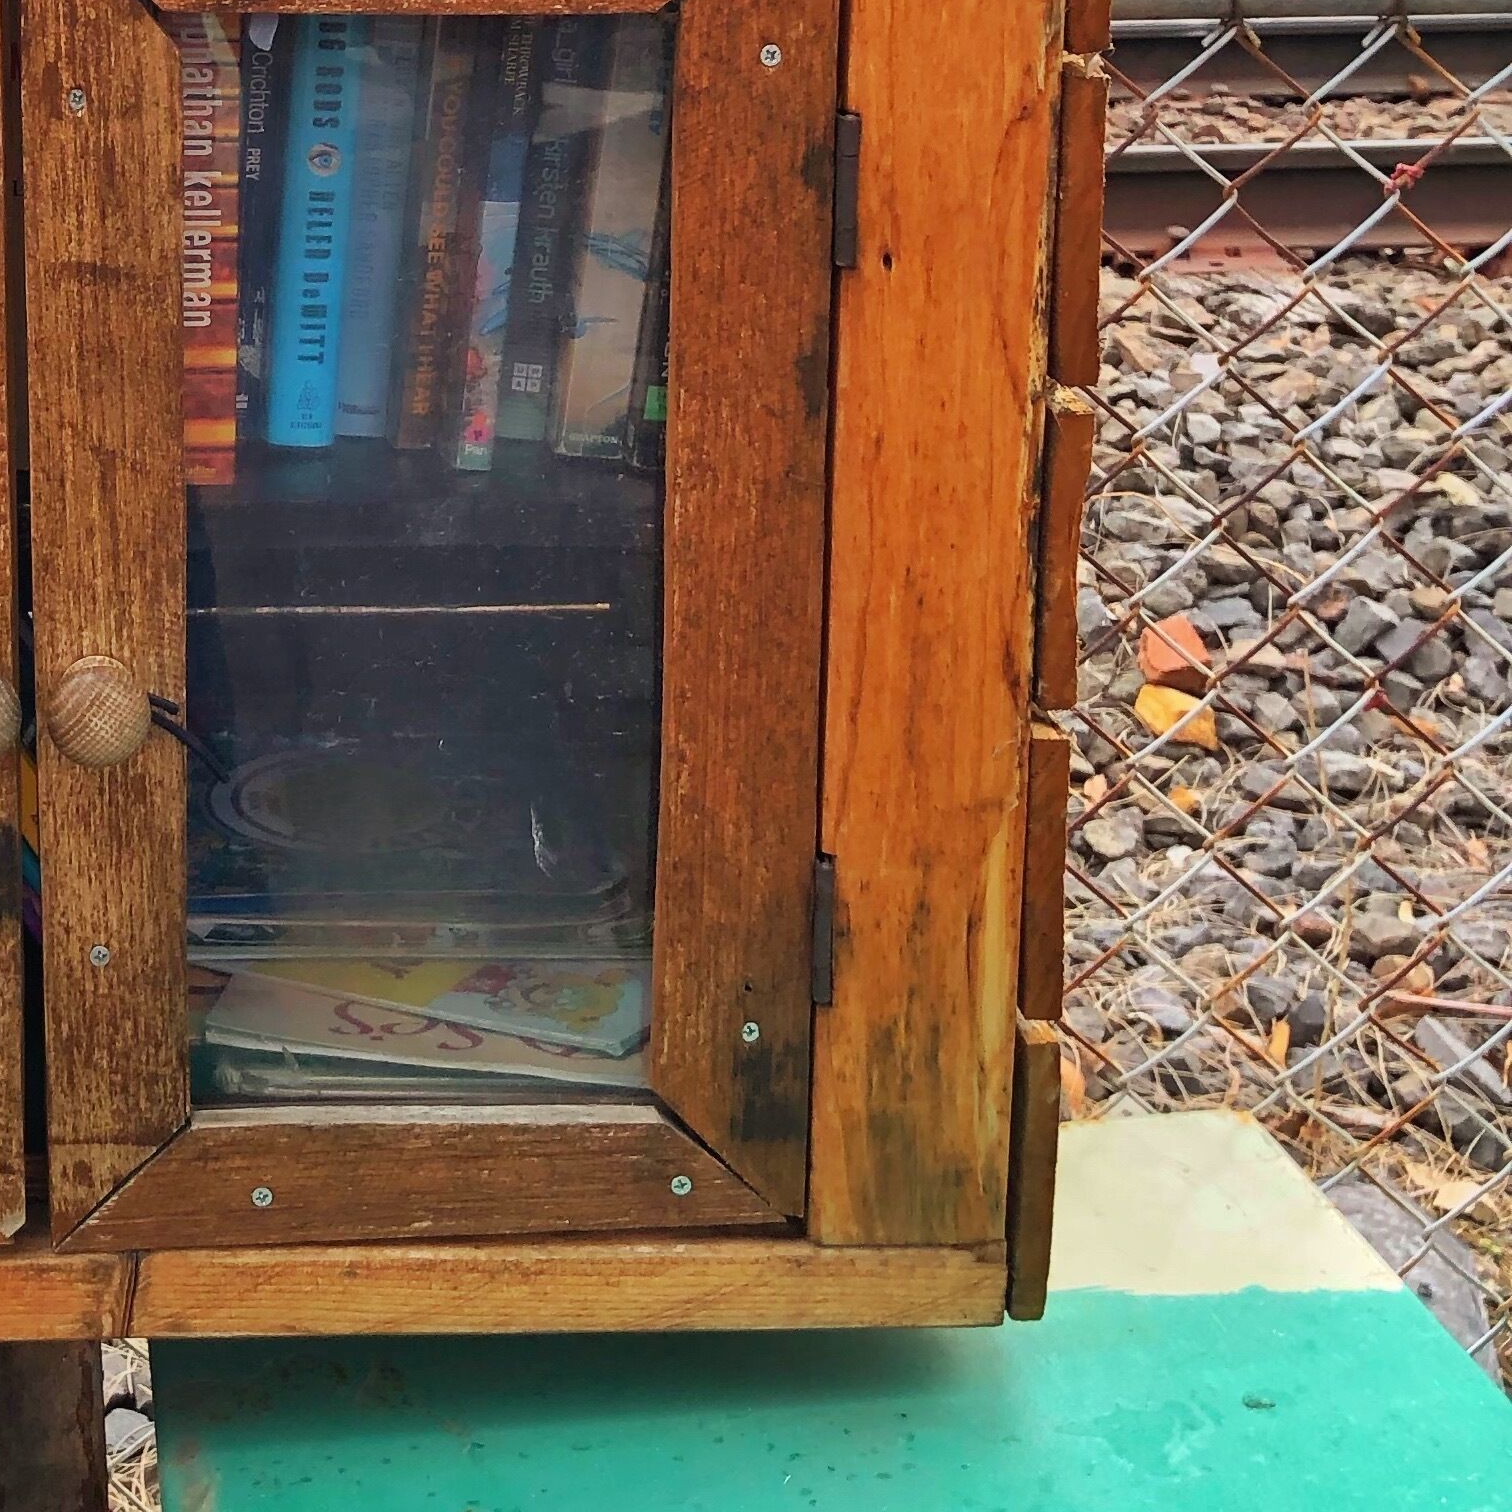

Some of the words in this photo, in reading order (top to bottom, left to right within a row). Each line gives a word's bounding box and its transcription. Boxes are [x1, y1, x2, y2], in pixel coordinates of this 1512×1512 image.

[247, 52, 274, 134] Crichton
[182, 170, 223, 328] kellerman
[419, 269, 444, 336] WHAT
[411, 354, 435, 416] HEAR
